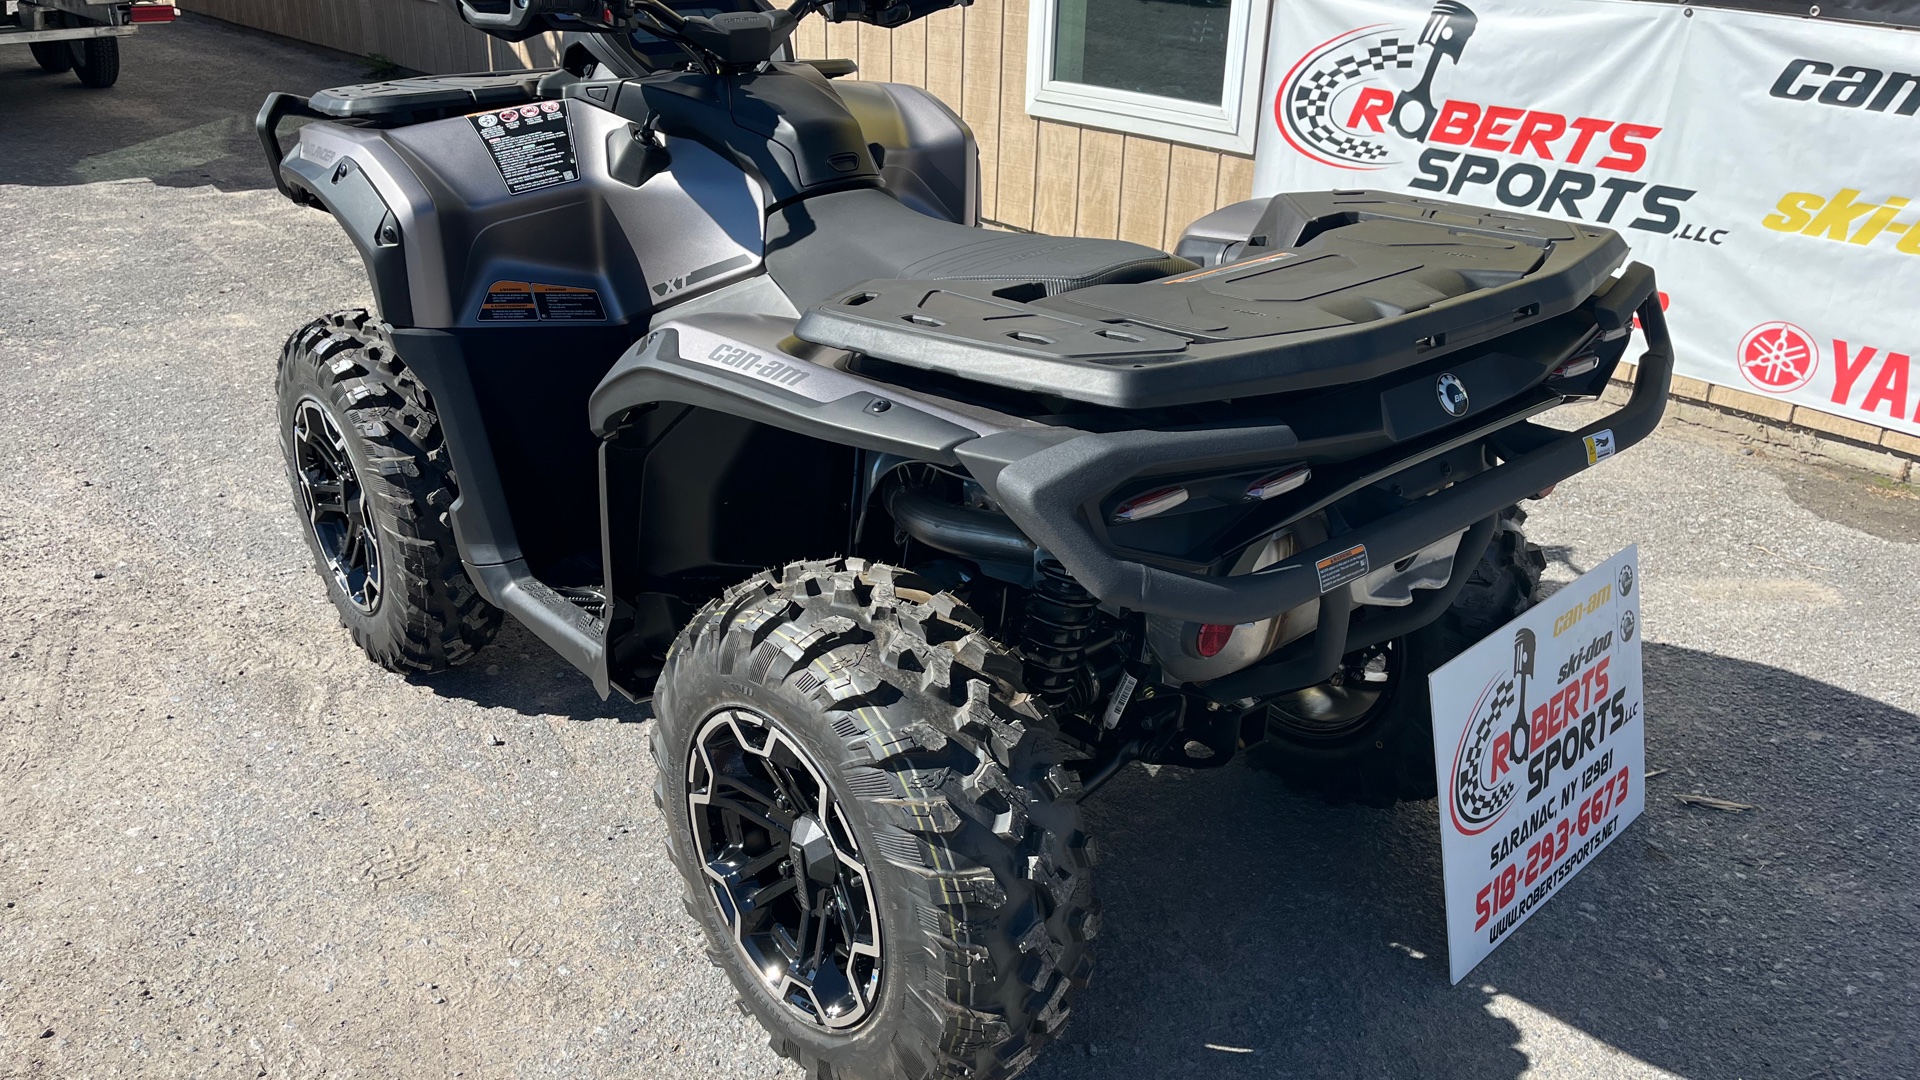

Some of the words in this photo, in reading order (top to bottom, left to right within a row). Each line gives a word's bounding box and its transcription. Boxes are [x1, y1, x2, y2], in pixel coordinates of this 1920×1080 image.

[1346, 86, 1663, 173] ROBERTS
[663, 272, 694, 296] XT
[707, 343, 811, 387] can-am
[1830, 338, 1920, 424] YA
[1553, 583, 1612, 638] can-am
[1557, 630, 1613, 685] ski-doo
[1491, 655, 1611, 784] ROBERTS
[1474, 765, 1629, 933] 518-293-6673
[1490, 797, 1558, 870] SARANAC,
[1561, 777, 1579, 810] NY
[1582, 748, 1614, 792] 12981
[1489, 814, 1619, 944] WWW.ROBERTSSPORTS.NET
